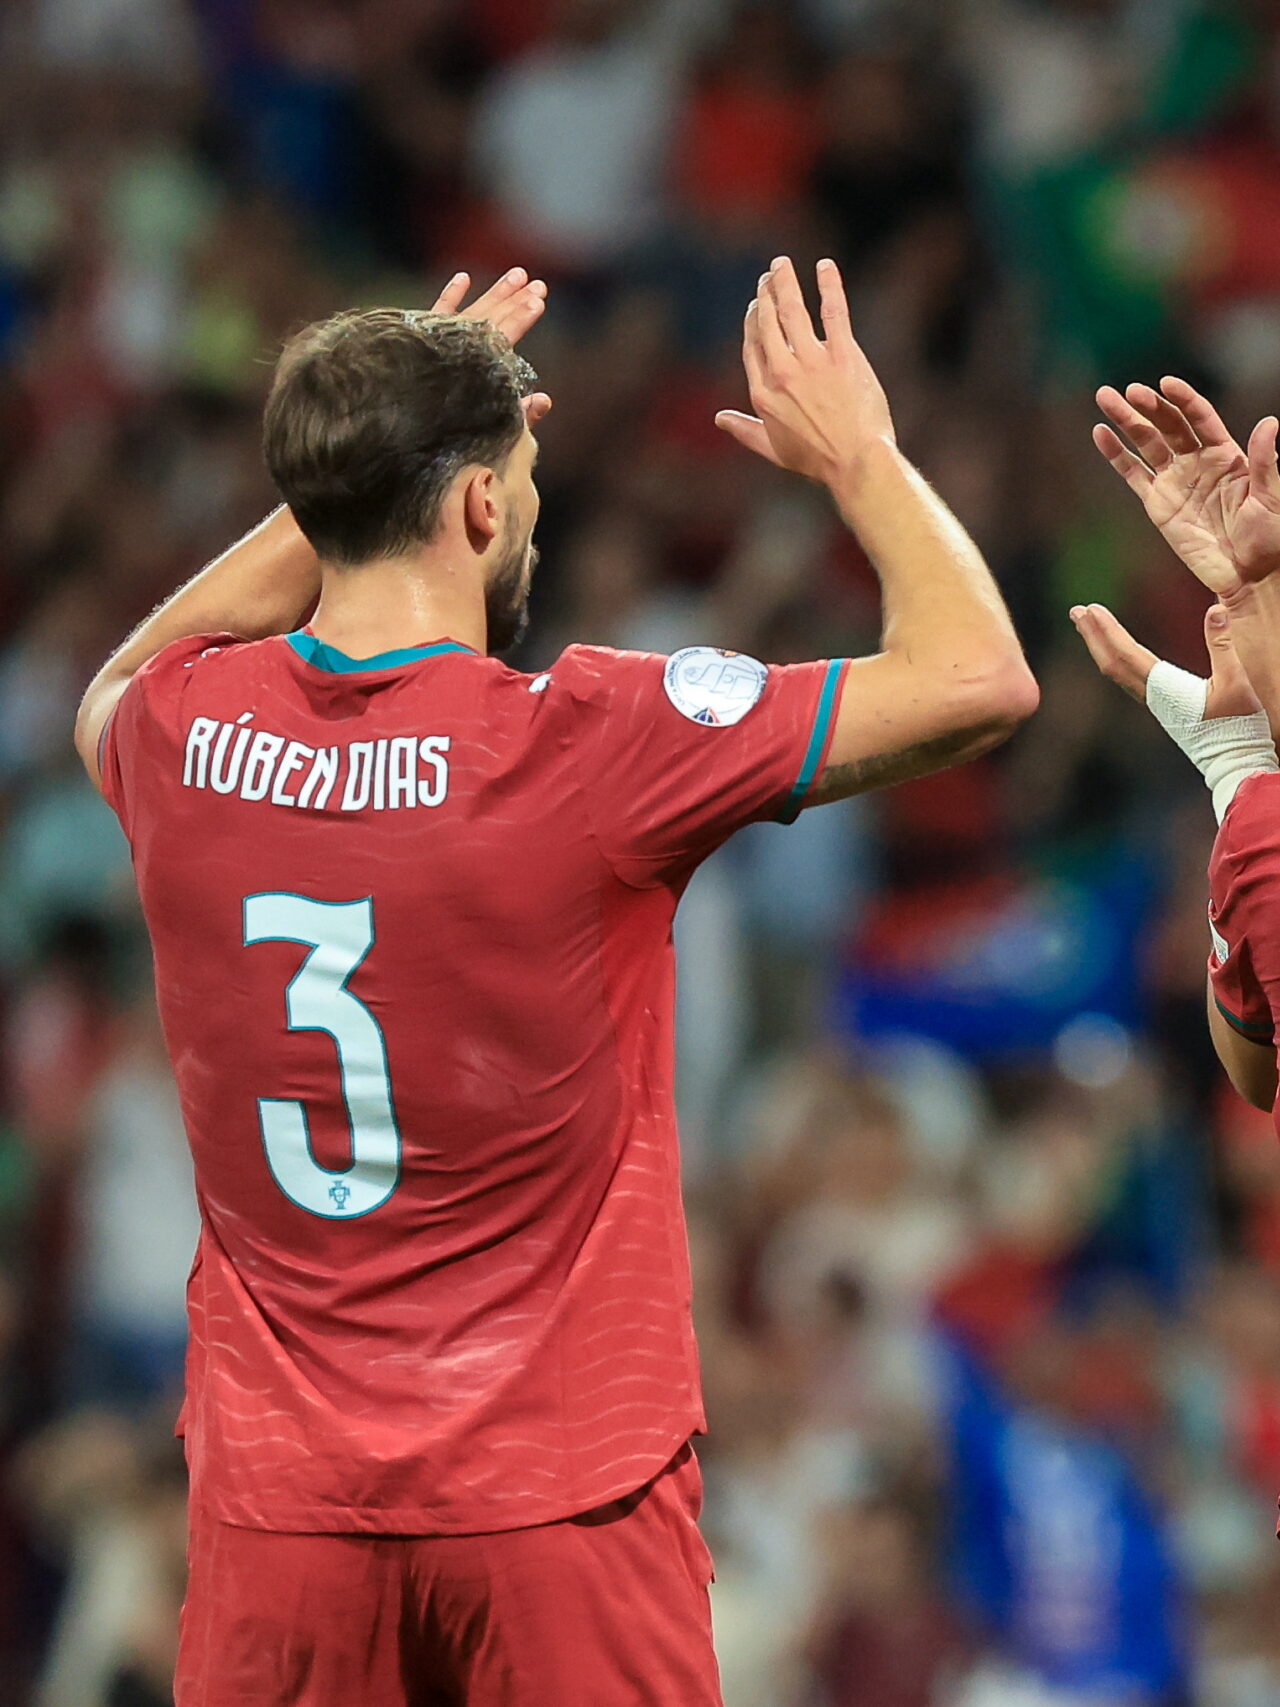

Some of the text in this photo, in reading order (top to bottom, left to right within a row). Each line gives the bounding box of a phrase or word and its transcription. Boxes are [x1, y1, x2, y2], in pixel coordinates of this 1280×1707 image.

[182, 711, 451, 812] RÚBEN DIAS
[242, 891, 403, 1221] 3
